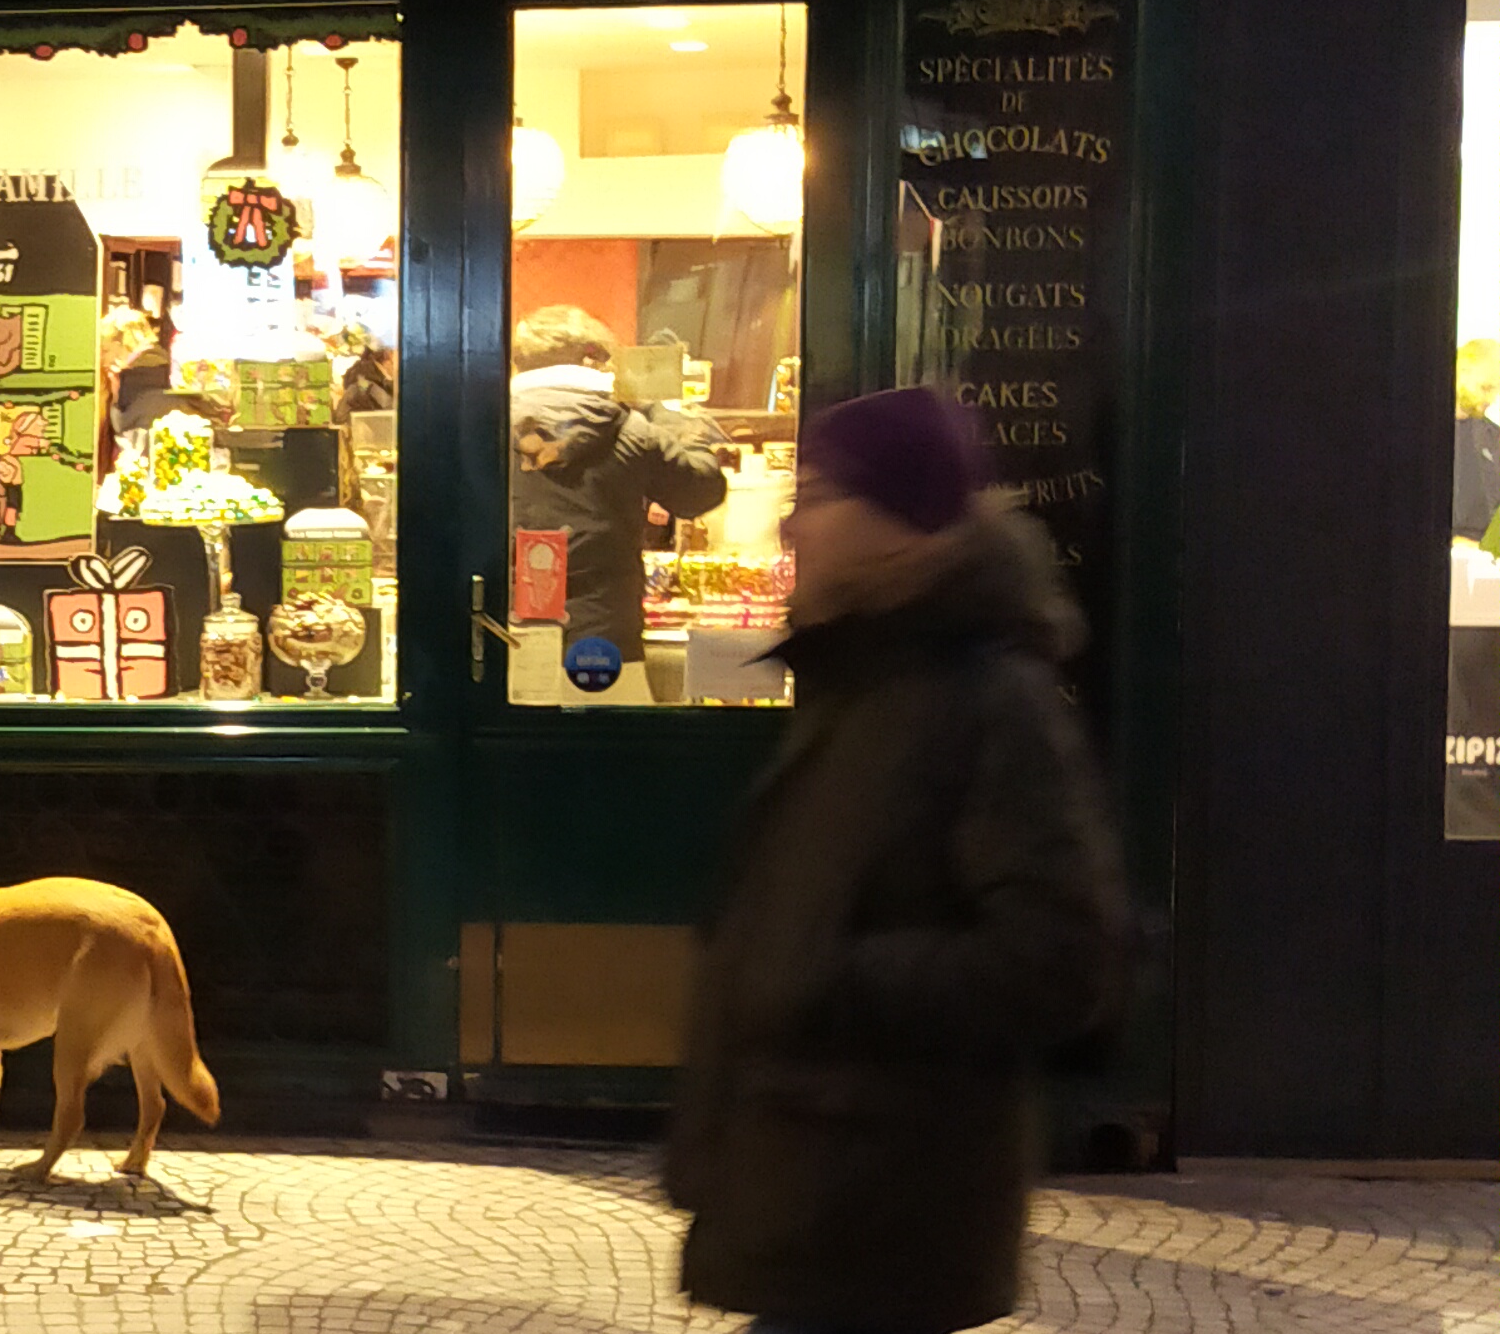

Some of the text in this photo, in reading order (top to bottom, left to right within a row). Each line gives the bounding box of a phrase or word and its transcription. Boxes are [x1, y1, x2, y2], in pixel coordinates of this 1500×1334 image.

[918, 123, 1112, 167] CHOCOLATS
[943, 224, 1085, 251] BONBONS
[936, 279, 1087, 309] NOUGATS
[955, 380, 1060, 410] CAKES
[964, 420, 1069, 446] LACES
